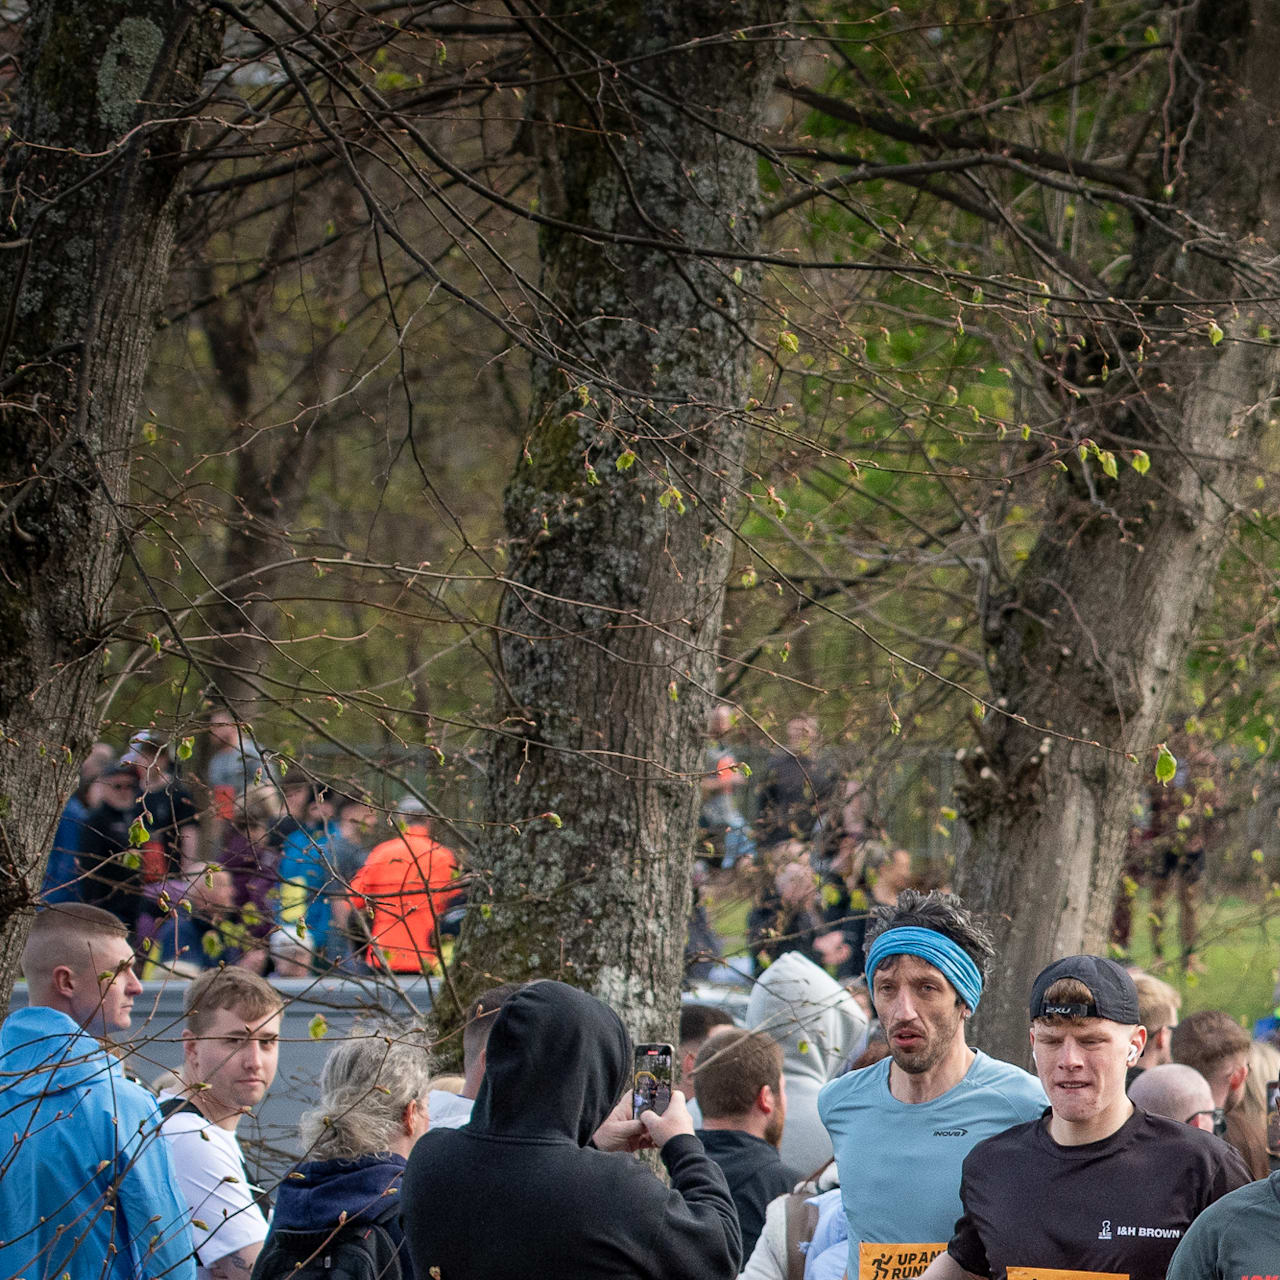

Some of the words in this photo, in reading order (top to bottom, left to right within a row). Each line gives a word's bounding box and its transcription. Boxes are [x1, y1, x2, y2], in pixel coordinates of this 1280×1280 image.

[1116, 1226, 1136, 1236] I&H
[1138, 1227, 1180, 1238] BROWN
[897, 1252, 917, 1266] UP
